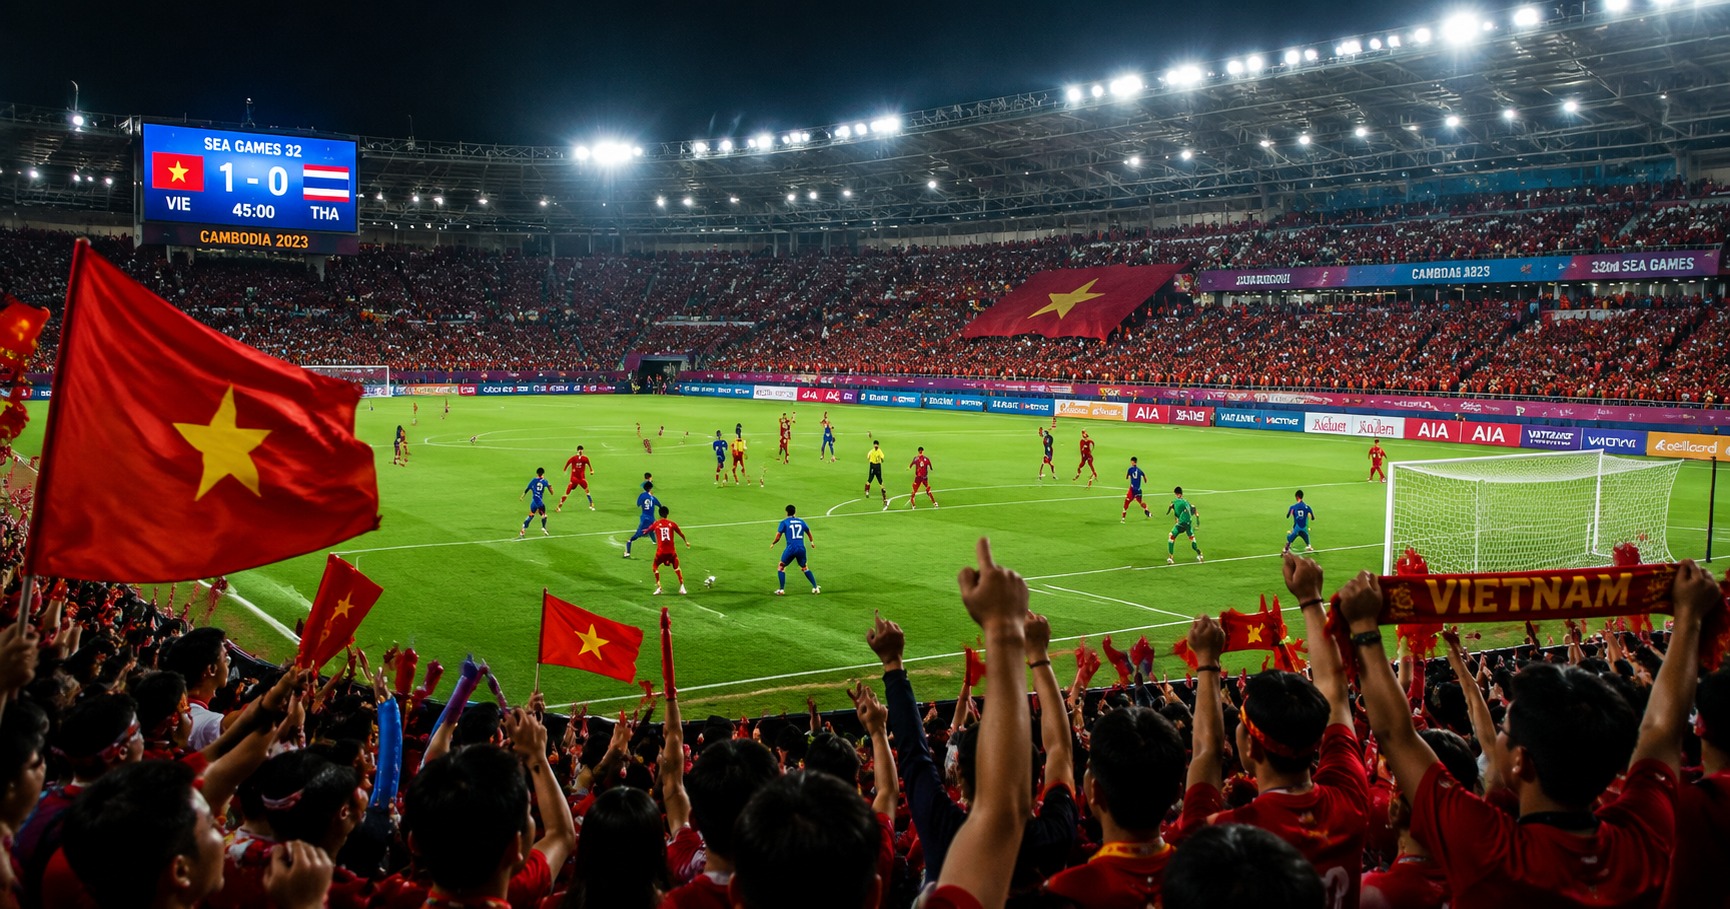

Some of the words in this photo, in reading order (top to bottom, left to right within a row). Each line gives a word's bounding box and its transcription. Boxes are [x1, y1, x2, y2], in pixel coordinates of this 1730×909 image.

[204, 137, 231, 152] SEA
[234, 140, 282, 156] GAMES
[285, 144, 302, 157] 32
[219, 162, 233, 193] 1
[268, 166, 288, 197] 0
[166, 196, 191, 211] VIE
[232, 203, 275, 219] 45:00
[310, 206, 339, 220] THA
[200, 230, 272, 247] CAMBODIA
[275, 234, 309, 249] 2023
[1622, 259, 1647, 272] SEA
[1650, 257, 1695, 272] GAMES
[1135, 406, 1160, 420] AIA
[1418, 422, 1449, 439] AIA
[1471, 425, 1505, 443] AIA
[789, 524, 803, 539] 12
[1425, 572, 1633, 615] VIETNAM
